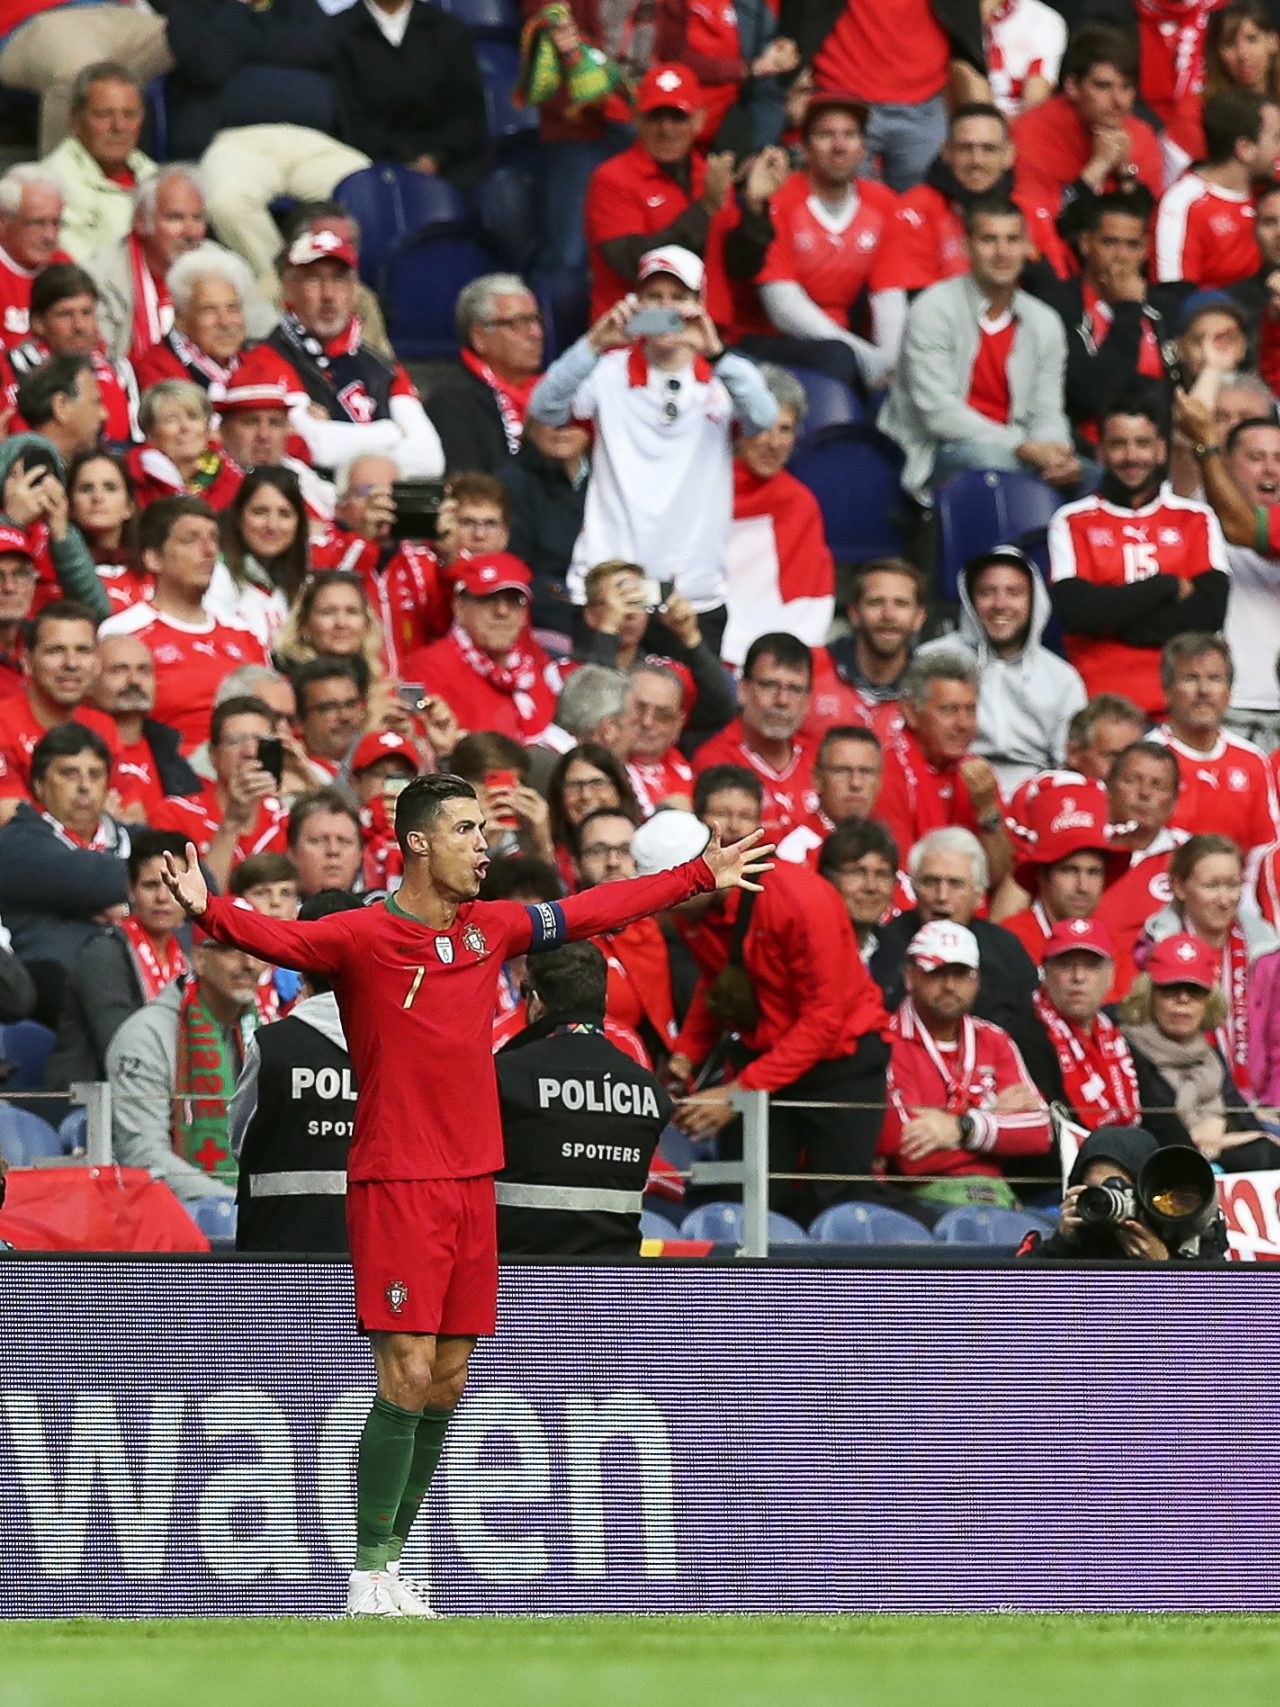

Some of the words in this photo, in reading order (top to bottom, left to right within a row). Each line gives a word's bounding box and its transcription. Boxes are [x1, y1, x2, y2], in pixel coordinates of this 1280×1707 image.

[1122, 542, 1160, 585] 15
[402, 965, 425, 1009] 7
[291, 1066, 359, 1101] POL
[538, 1072, 661, 1119] POLÍCIA
[561, 1142, 641, 1163] SPOTTERS
